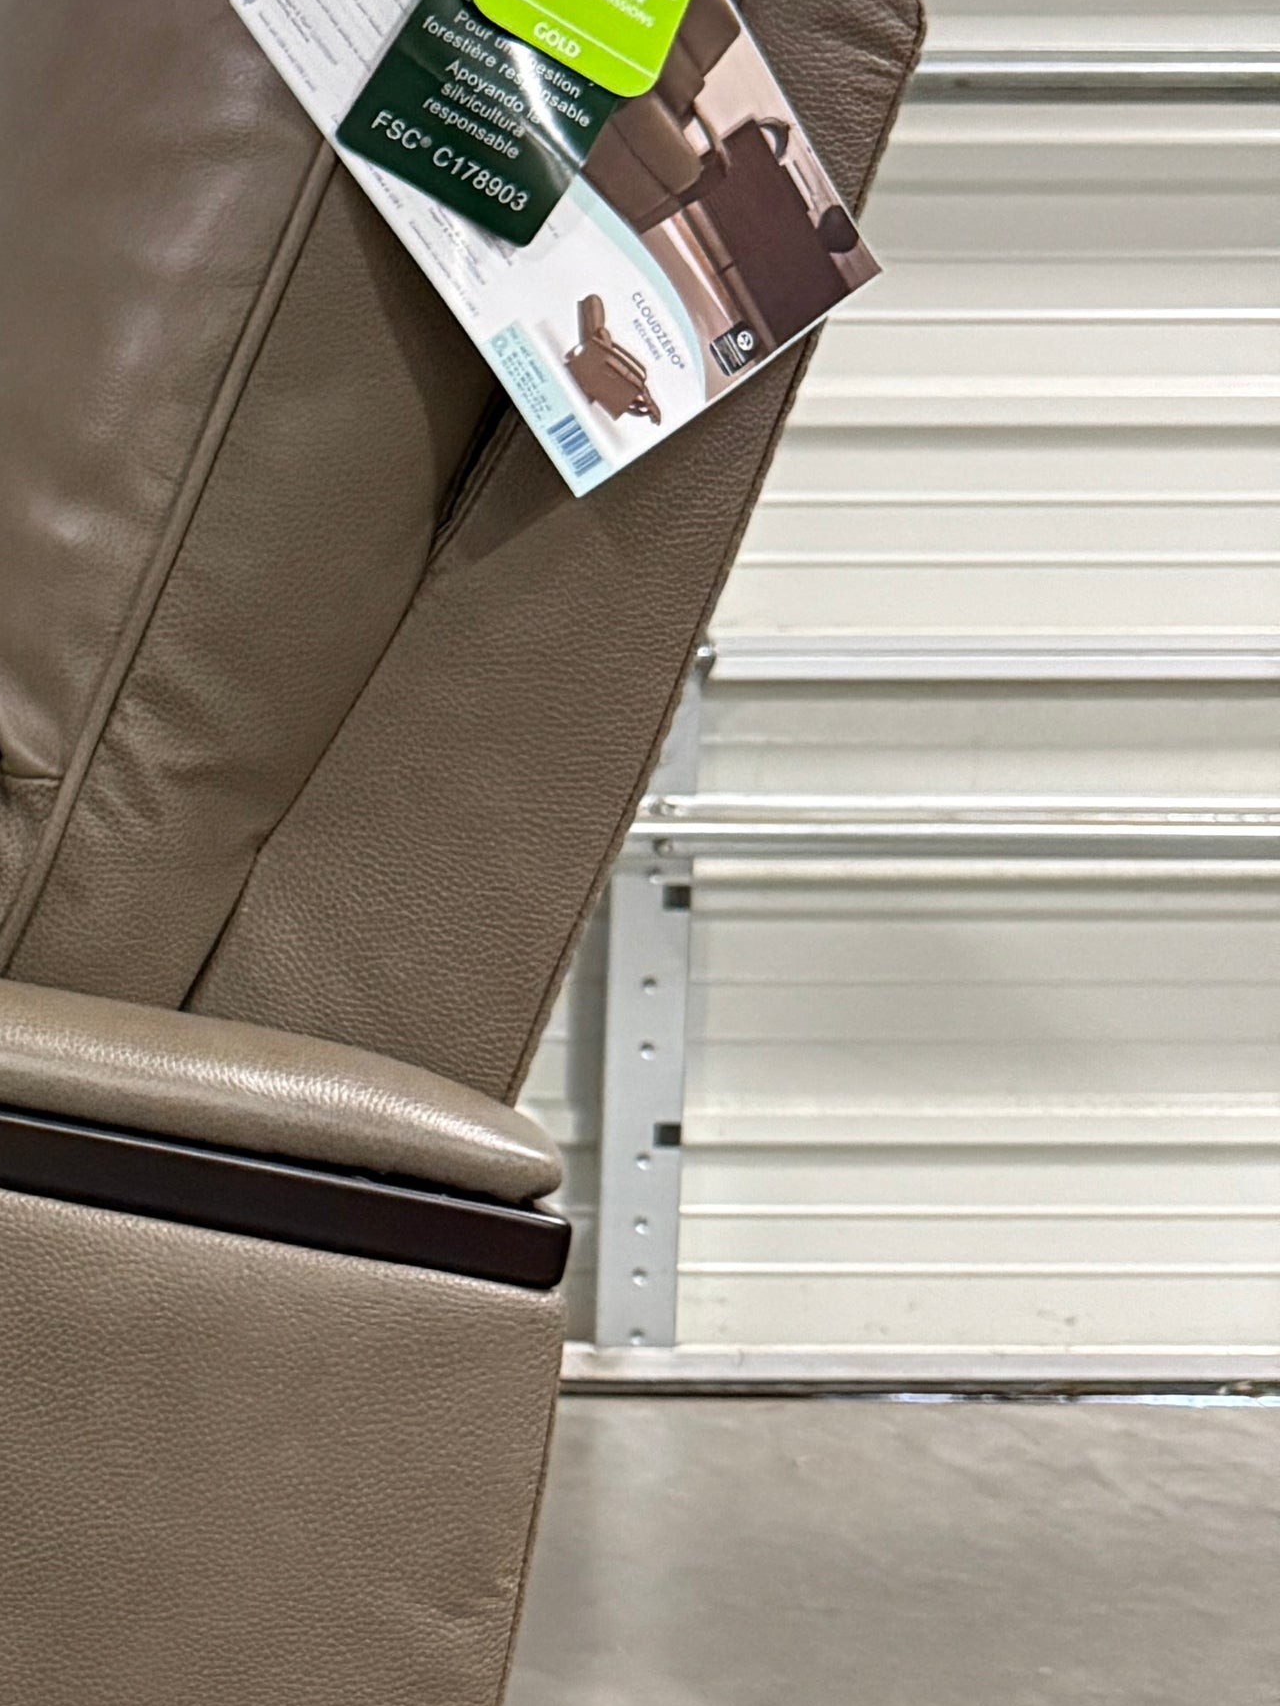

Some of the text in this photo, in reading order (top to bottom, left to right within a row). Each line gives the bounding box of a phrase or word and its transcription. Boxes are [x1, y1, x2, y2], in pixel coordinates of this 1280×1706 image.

[422, 14, 495, 68] forestière
[454, 9, 492, 40] Pour
[533, 22, 581, 59] GOLD
[441, 82, 526, 138] silvicultura
[445, 59, 524, 112] Apoyando
[422, 97, 520, 160] responsable
[433, 147, 528, 211] C178903
